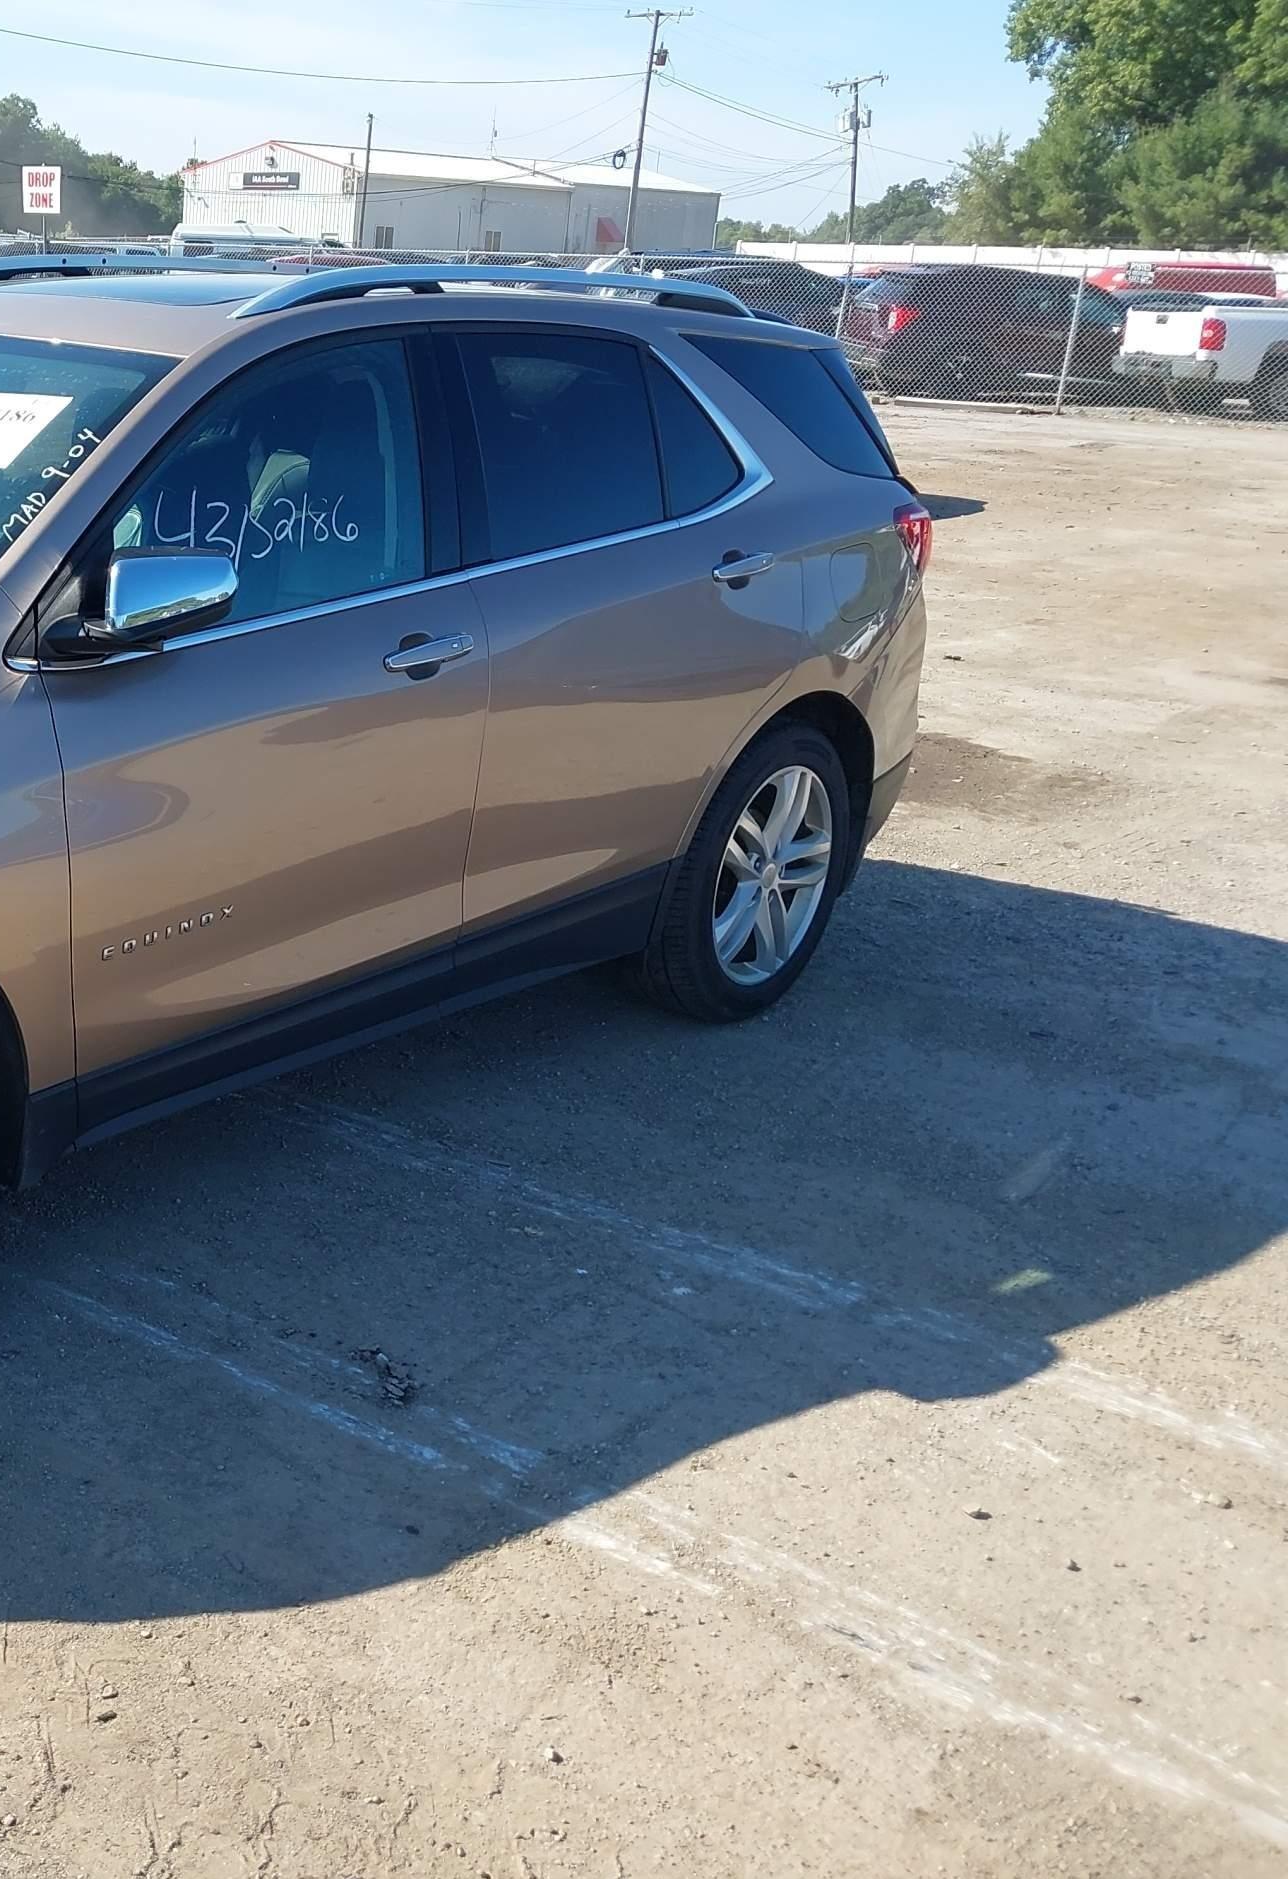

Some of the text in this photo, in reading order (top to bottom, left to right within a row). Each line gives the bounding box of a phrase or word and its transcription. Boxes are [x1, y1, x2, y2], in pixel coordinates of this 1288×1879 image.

[28, 171, 56, 188] DROP
[29, 192, 55, 209] ZONE
[2, 491, 47, 542] MAD
[154, 485, 359, 572] 43152186
[101, 904, 234, 961] EQUINOX
